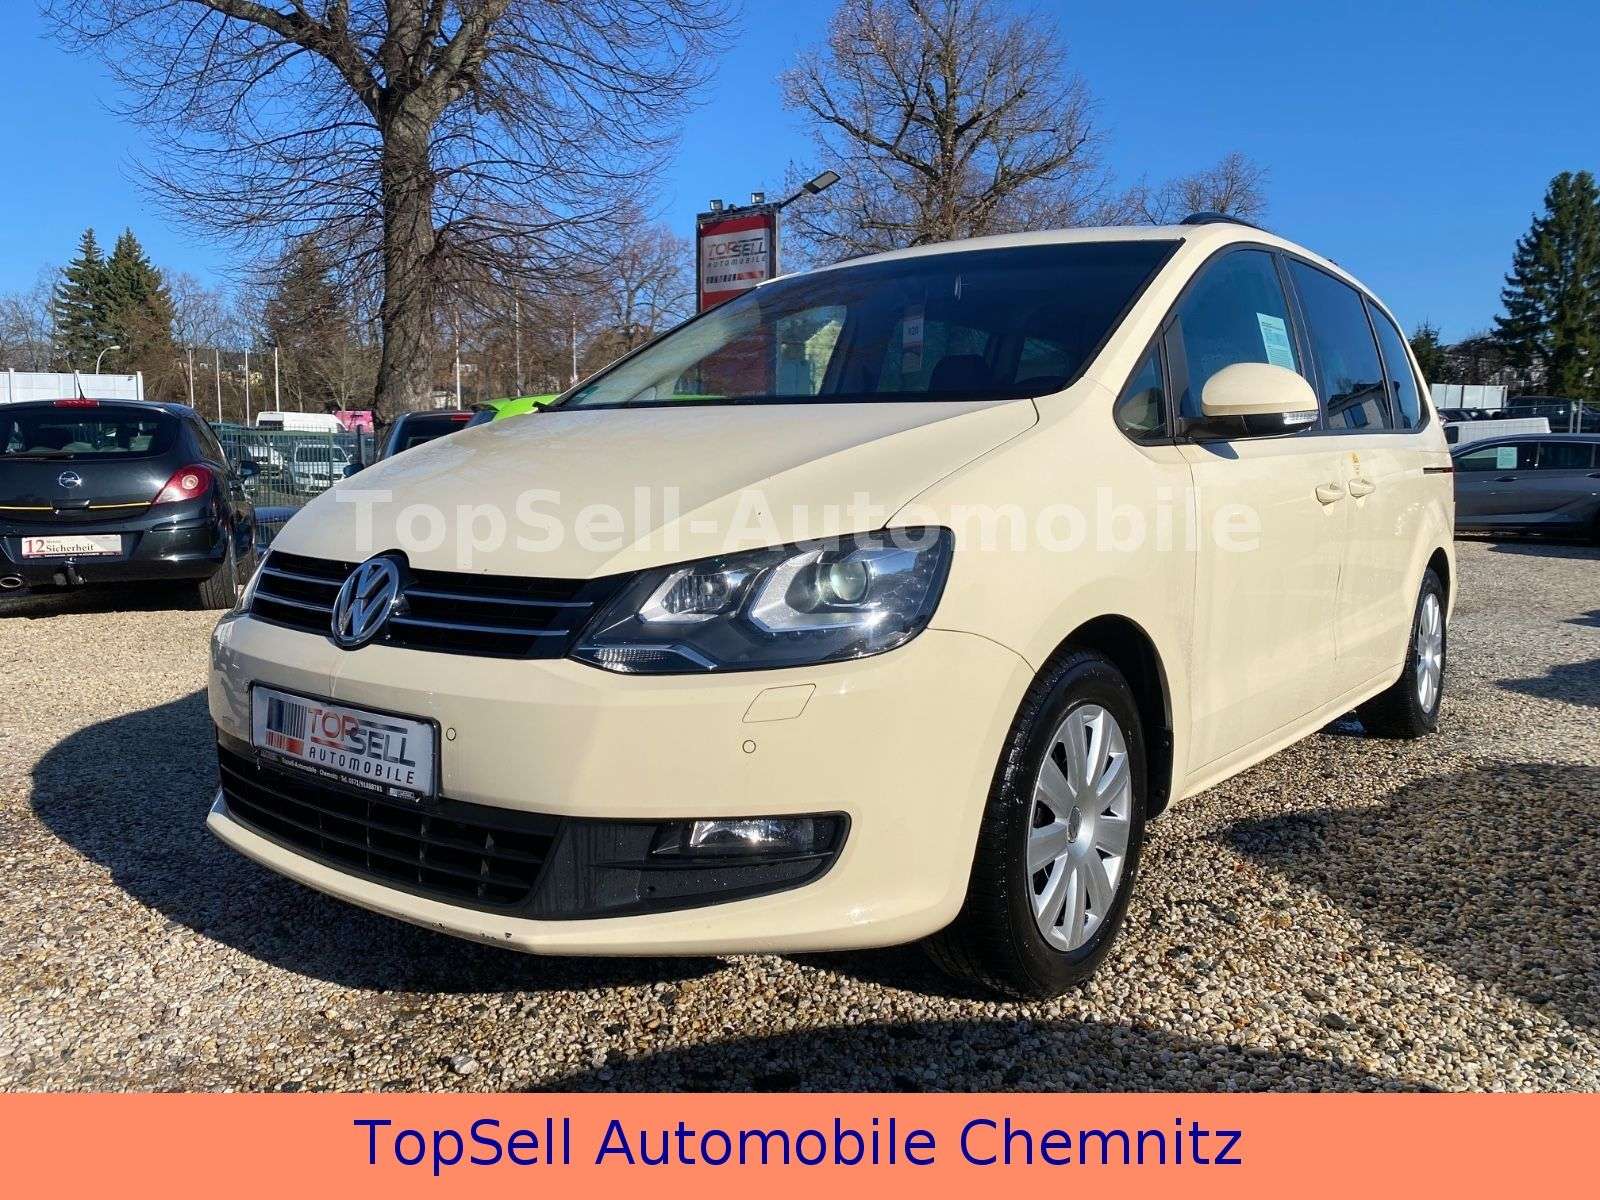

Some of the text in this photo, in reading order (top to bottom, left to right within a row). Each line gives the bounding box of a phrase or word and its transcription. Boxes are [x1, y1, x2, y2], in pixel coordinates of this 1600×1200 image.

[708, 238, 766, 259] TOPSELL
[706, 256, 766, 268] AUTOMOBILE
[25, 539, 45, 553] 12
[46, 543, 94, 553] Sicherheit
[308, 708, 415, 767] TOPSELL
[309, 746, 415, 785] AUTOMOBILE
